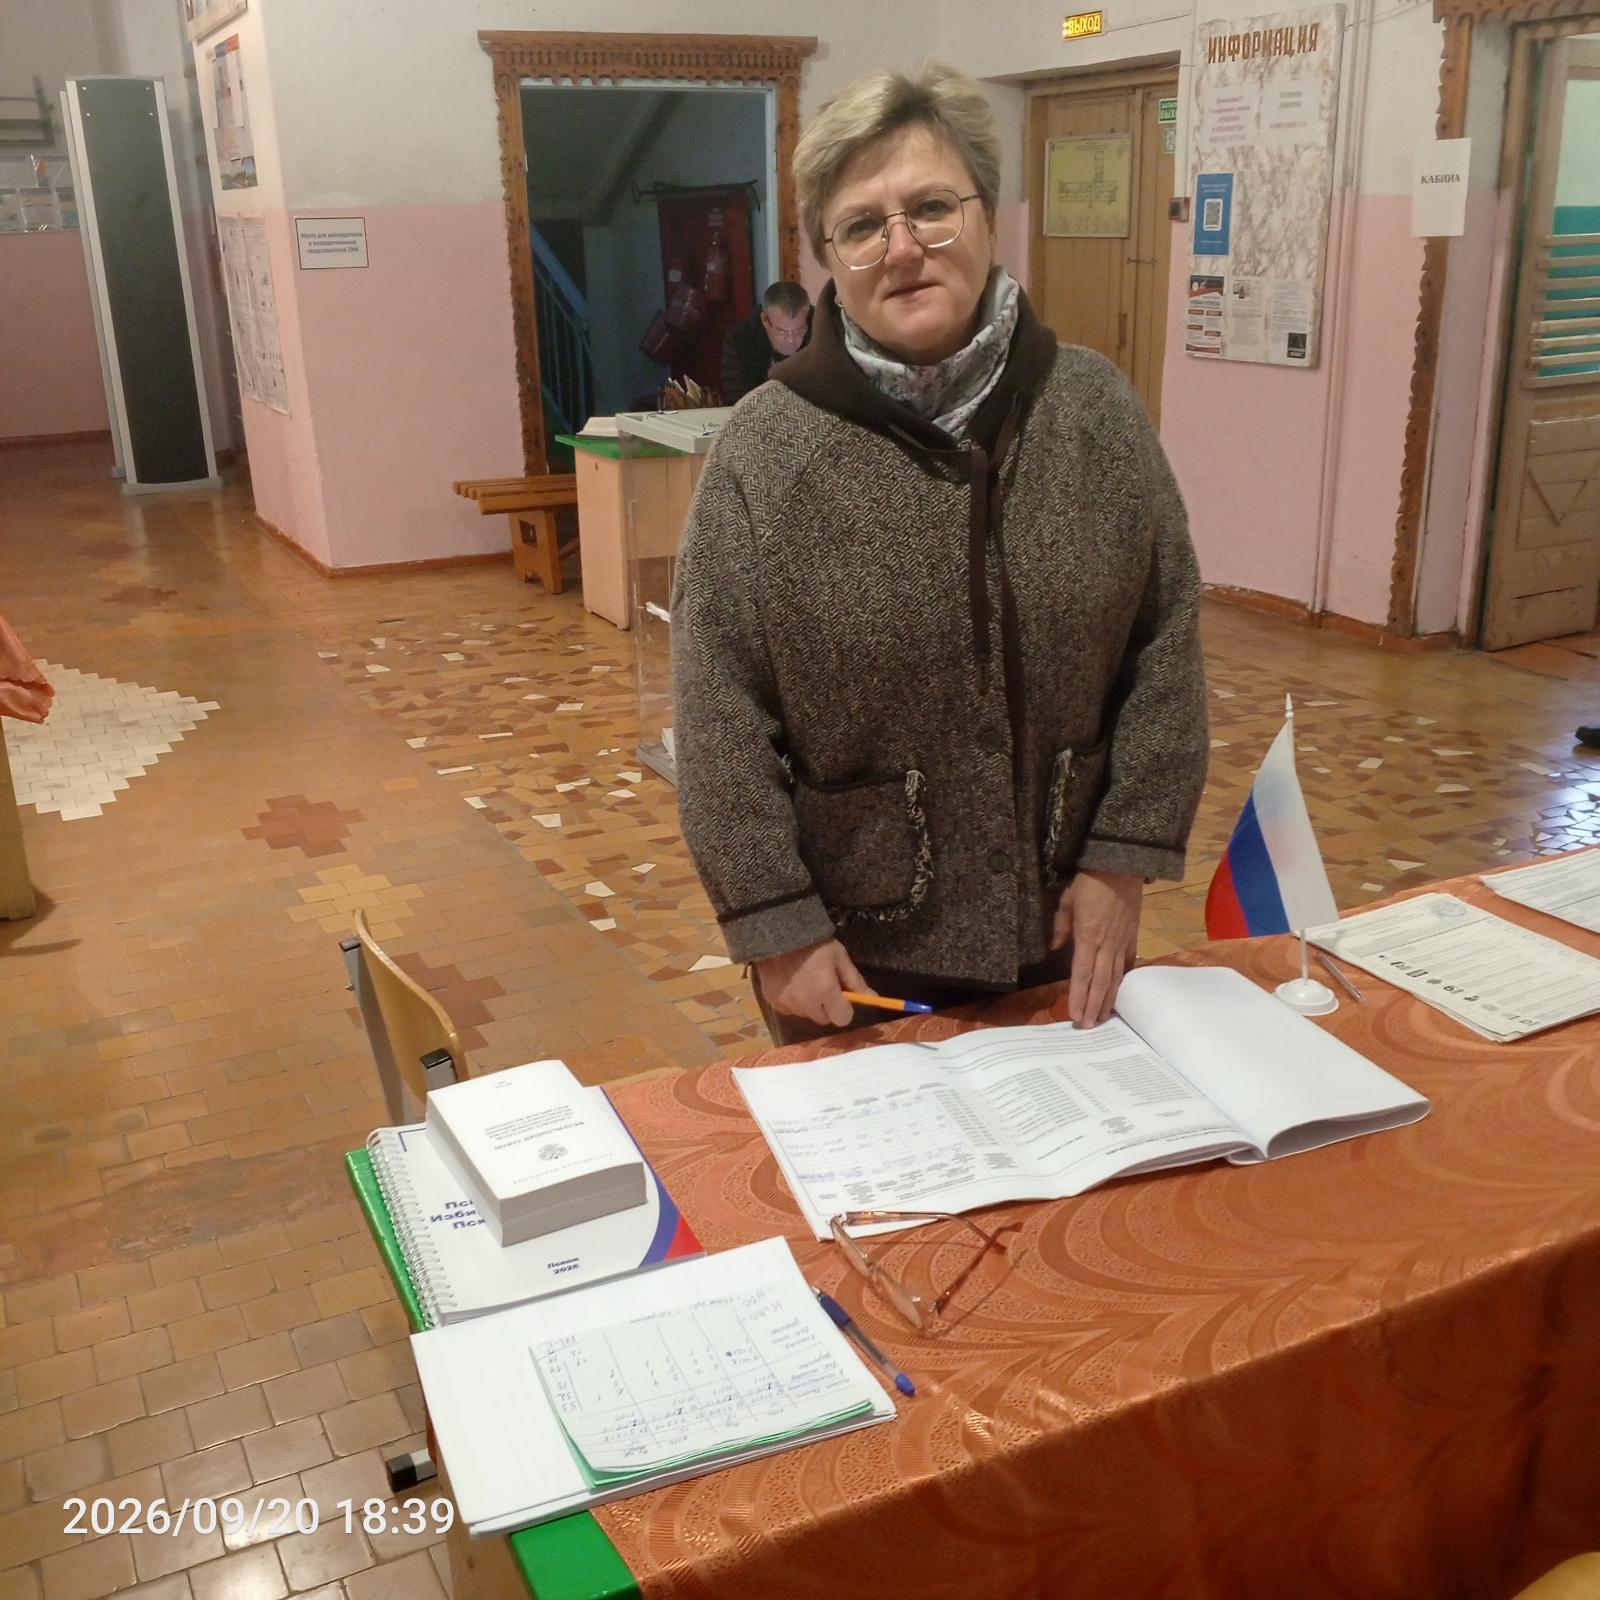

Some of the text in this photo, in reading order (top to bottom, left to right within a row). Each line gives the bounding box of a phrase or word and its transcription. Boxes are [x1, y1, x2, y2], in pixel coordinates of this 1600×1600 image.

[1066, 15, 1101, 36] ВЫХОД
[1208, 22, 1320, 64] ИНФОРМАЦИЯ
[1421, 174, 1460, 184] КАБИНА
[430, 1210, 477, 1223] Изби
